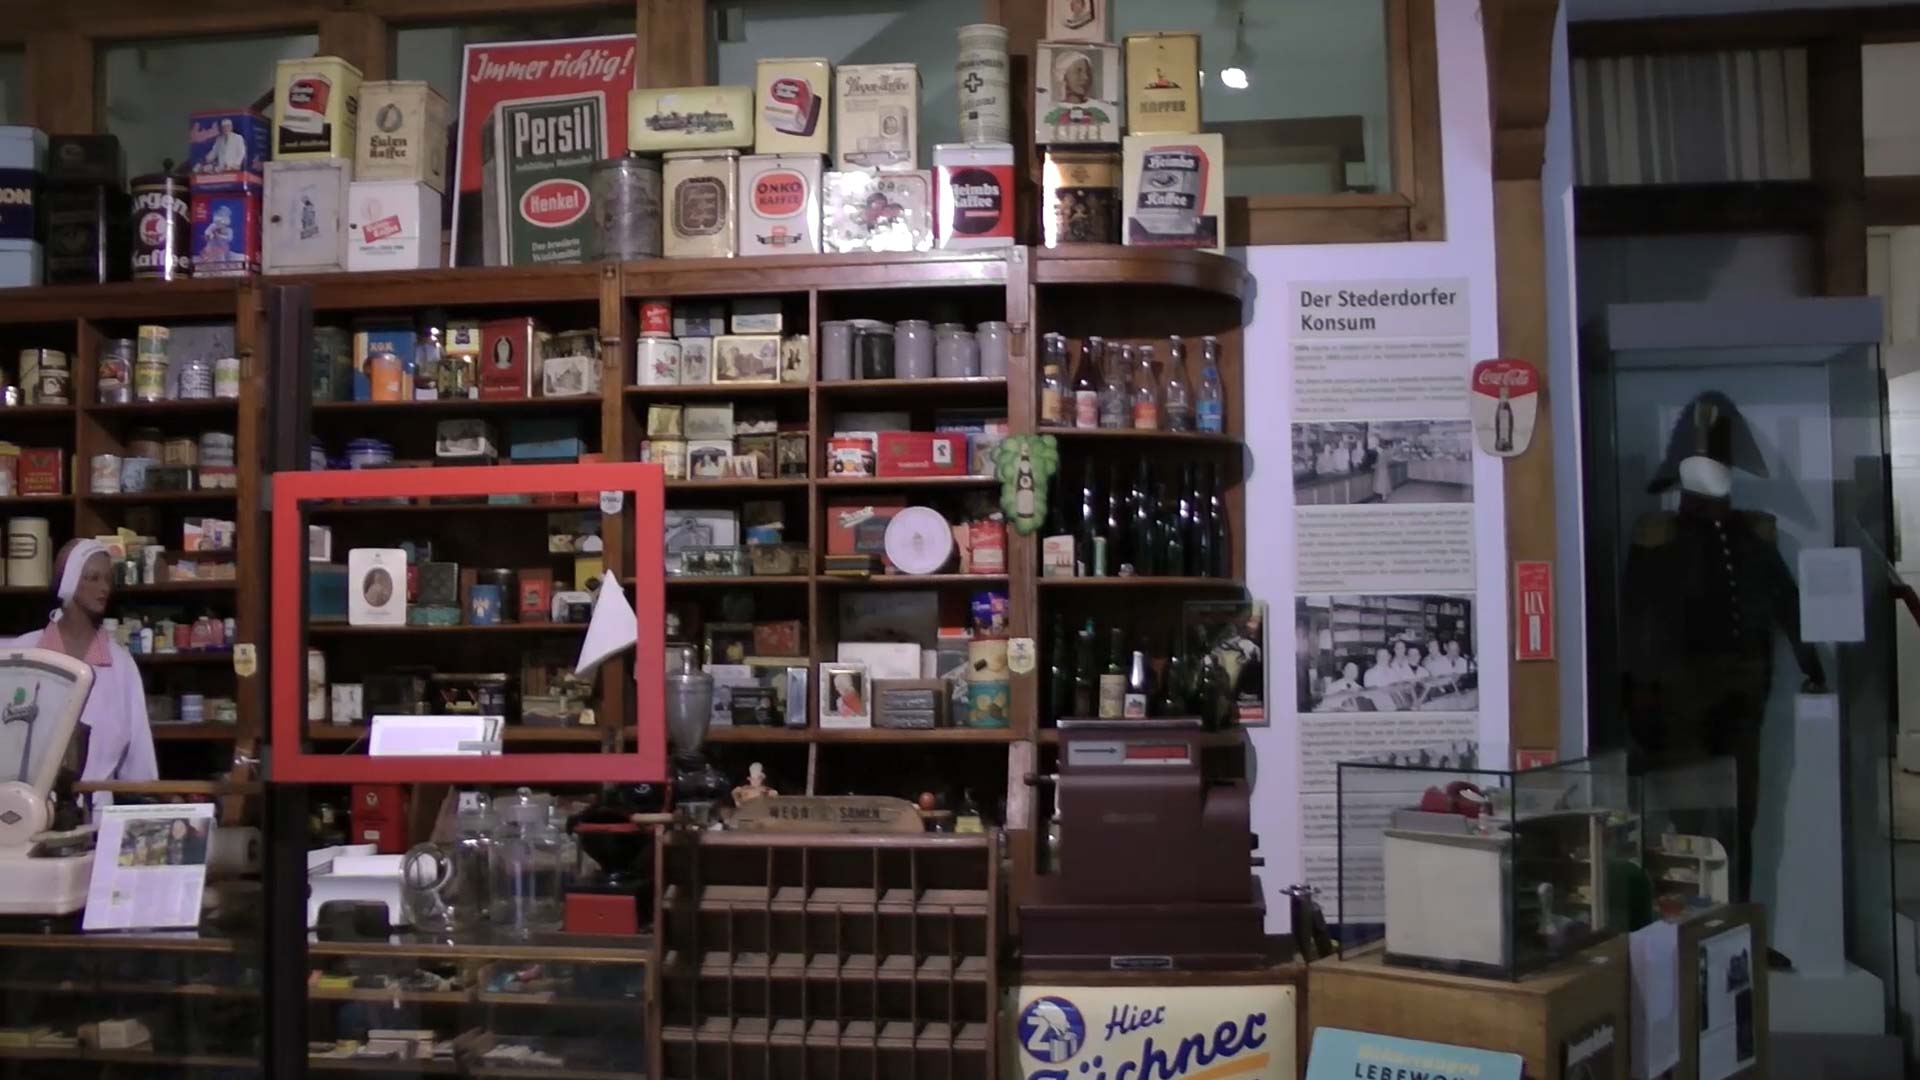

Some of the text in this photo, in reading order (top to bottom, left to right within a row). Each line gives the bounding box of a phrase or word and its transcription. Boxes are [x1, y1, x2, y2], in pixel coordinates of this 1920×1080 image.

[550, 46, 635, 82] richtig!
[1140, 101, 1186, 113] KAFFEE
[514, 104, 592, 158] Persil
[757, 182, 801, 194] ONKO
[529, 189, 580, 213] Henkel
[1145, 191, 1187, 206] Kaffee
[1301, 287, 1457, 307] Der Stederdorfer
[1301, 314, 1376, 331] Konsum
[1104, 1003, 1166, 1041] Hier
[1026, 1012, 1267, 1080] üchner
[1354, 1062, 1463, 1080] LEBEW
